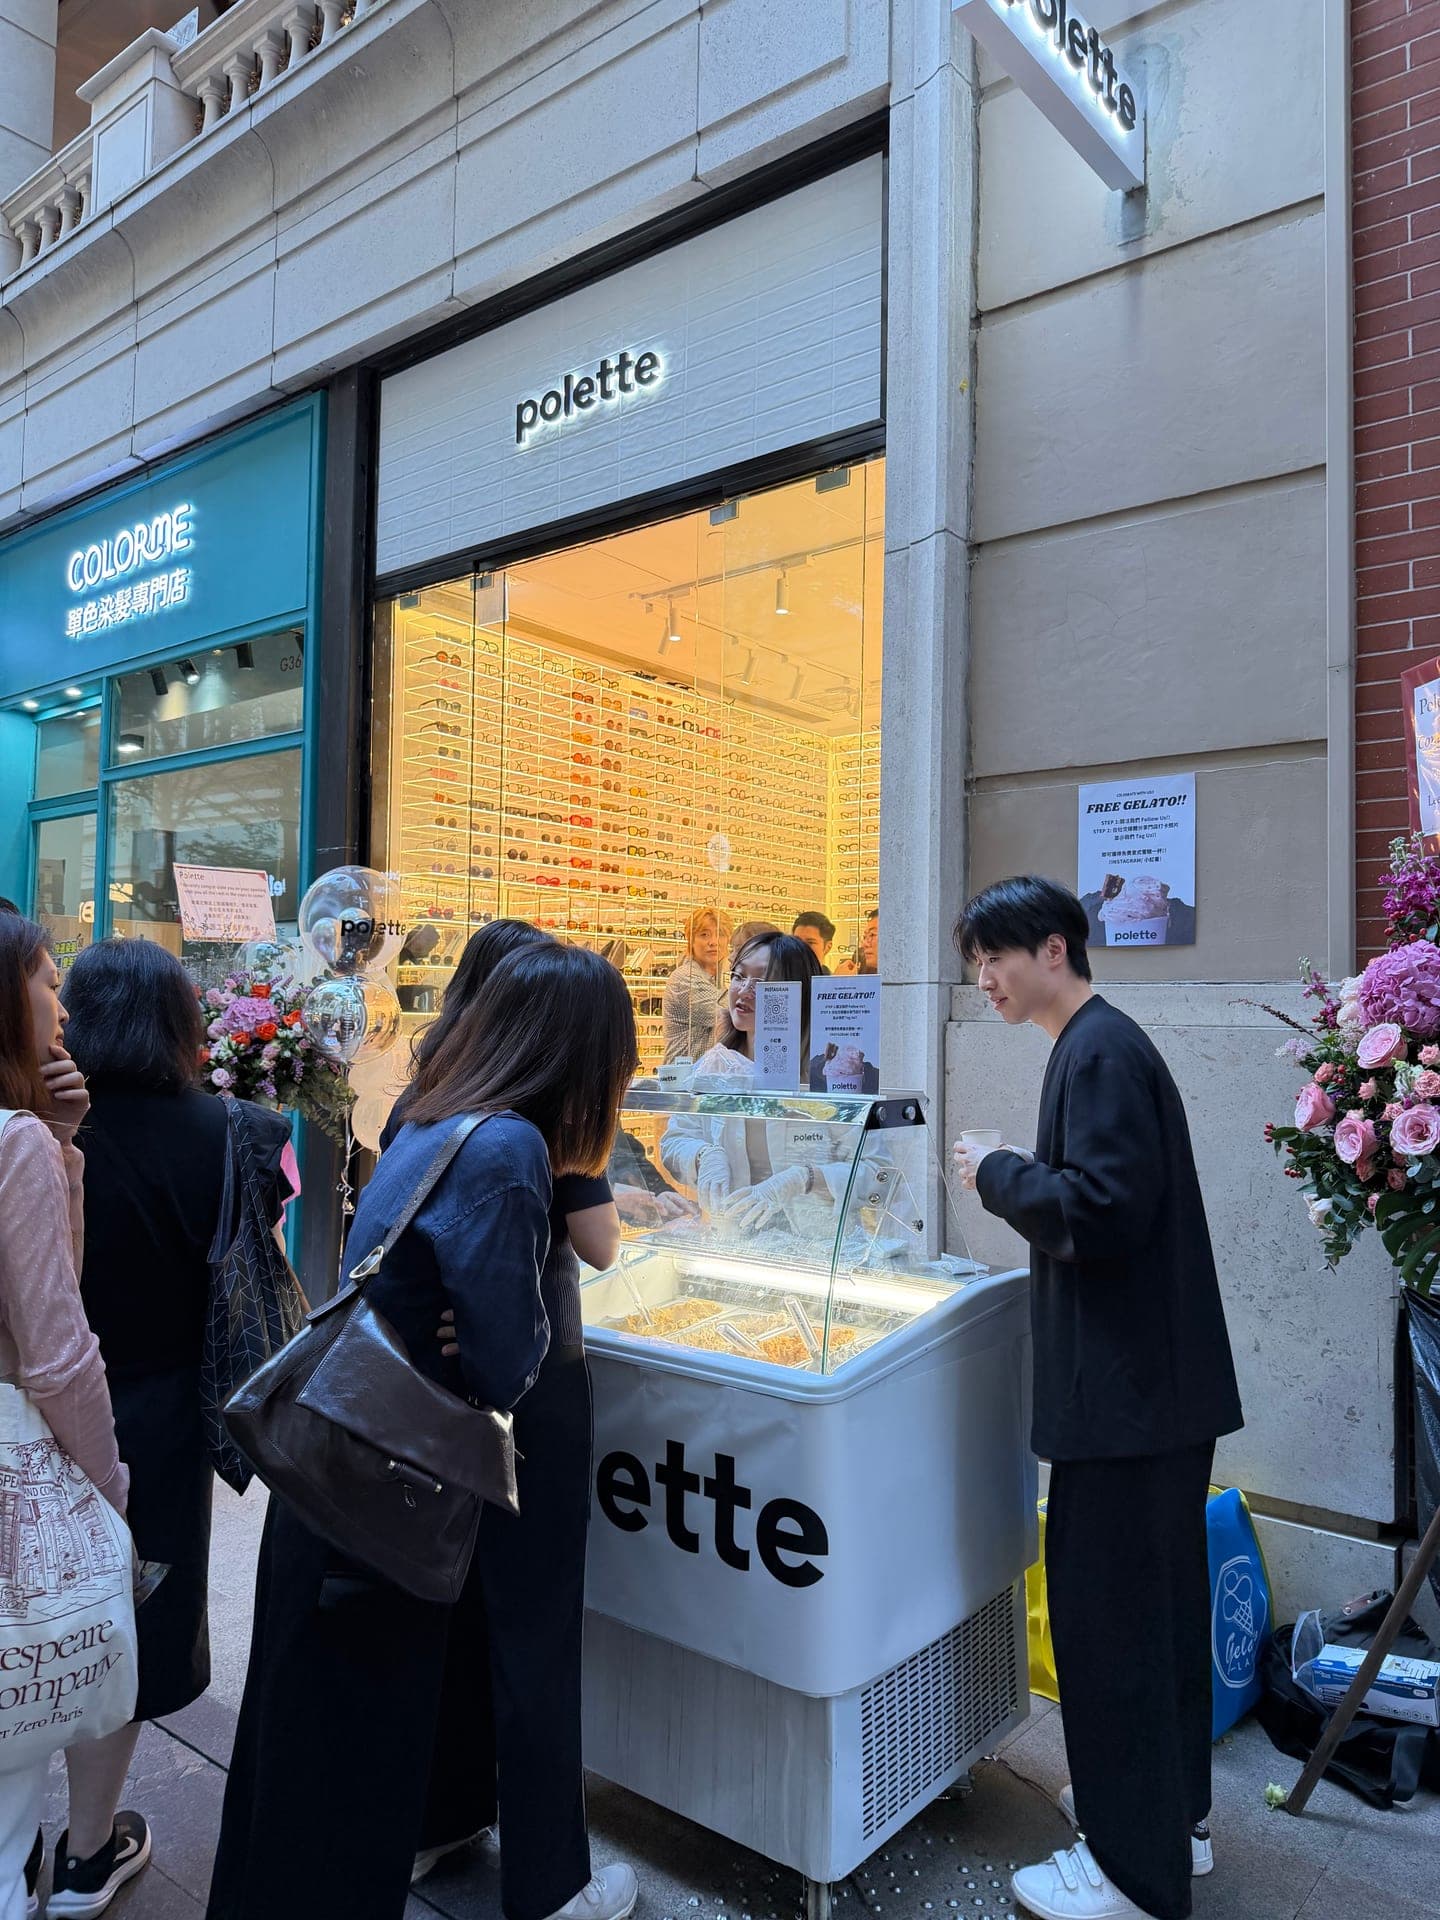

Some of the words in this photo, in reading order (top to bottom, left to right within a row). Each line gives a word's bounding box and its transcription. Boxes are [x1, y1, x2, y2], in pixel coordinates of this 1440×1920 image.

[1006, 0, 1137, 132] olette
[515, 351, 660, 444] polette
[67, 503, 192, 592] COLORME
[66, 567, 191, 638] 單色染髮專門店
[1087, 802, 1121, 814] FREE
[1124, 795, 1187, 810] GELATO!!
[341, 919, 407, 936] polette
[1115, 929, 1158, 942] polette
[817, 992, 838, 1000] FREE
[832, 1082, 857, 1090] polette
[793, 1133, 823, 1143] polette
[596, 1439, 829, 1588] ette
[0, 1619, 113, 1679] espeare
[0, 1652, 123, 1710] ompany
[13, 1719, 47, 1736] Zero
[51, 1705, 84, 1724] Paris
